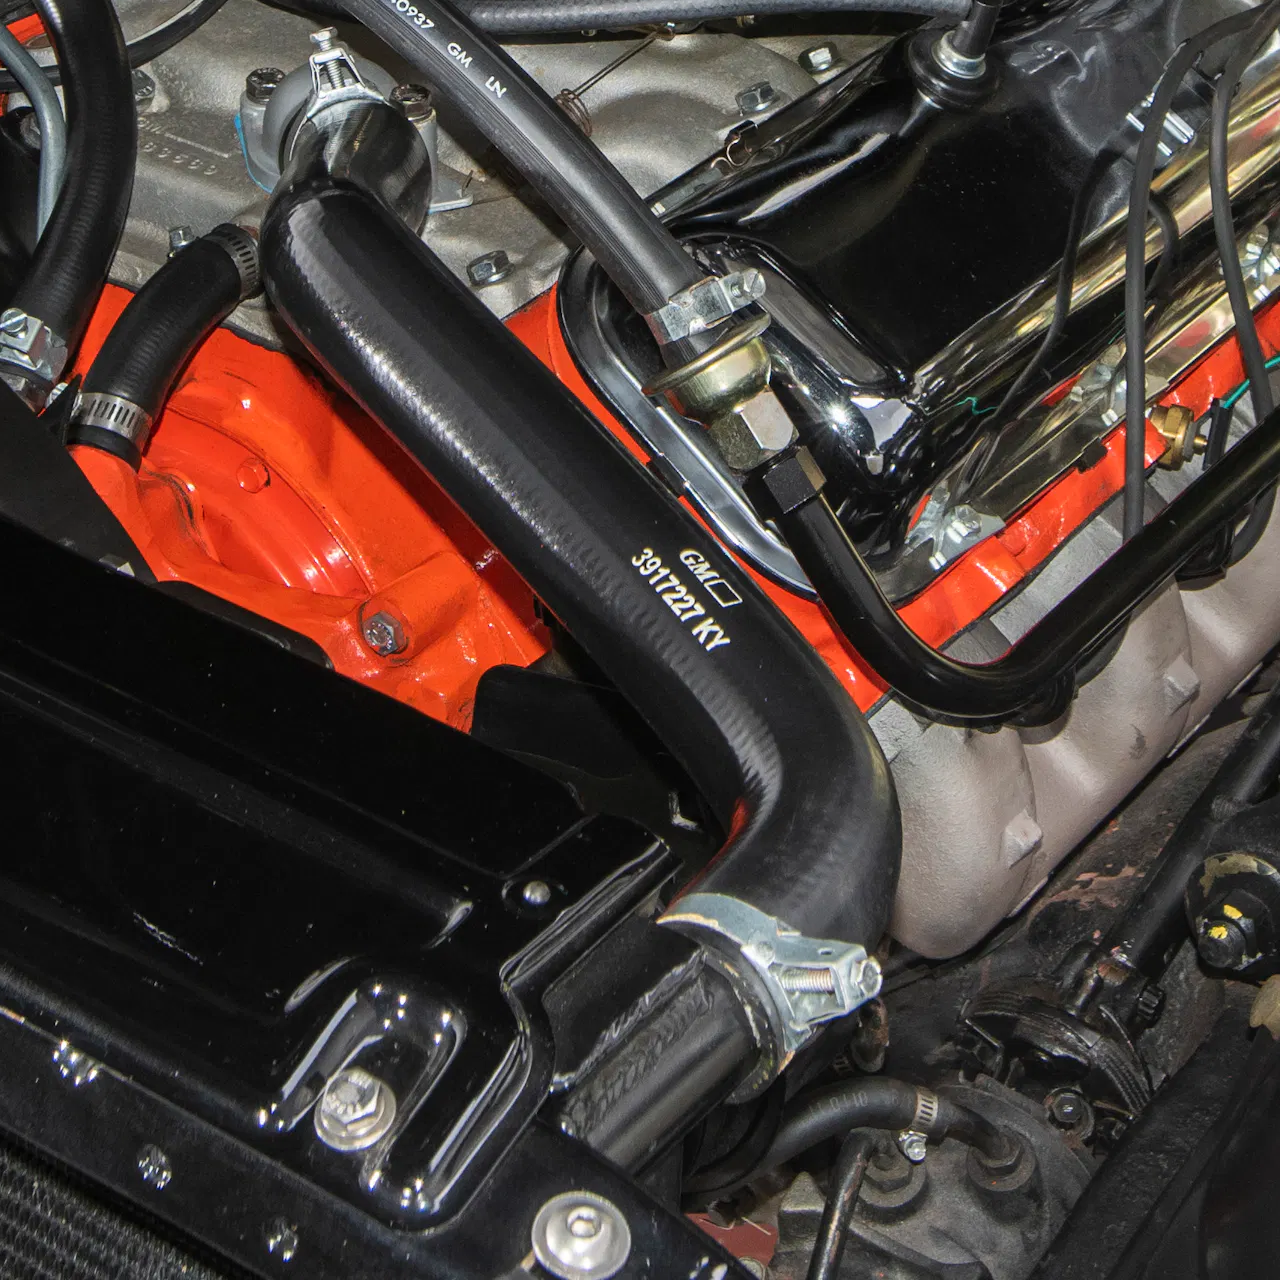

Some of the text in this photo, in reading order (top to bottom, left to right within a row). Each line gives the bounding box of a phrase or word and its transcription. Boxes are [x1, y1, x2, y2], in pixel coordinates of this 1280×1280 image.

[446, 41, 473, 69] GM
[484, 75, 508, 99] LN
[679, 548, 720, 584] GM
[631, 546, 731, 652] 3917227 KY
